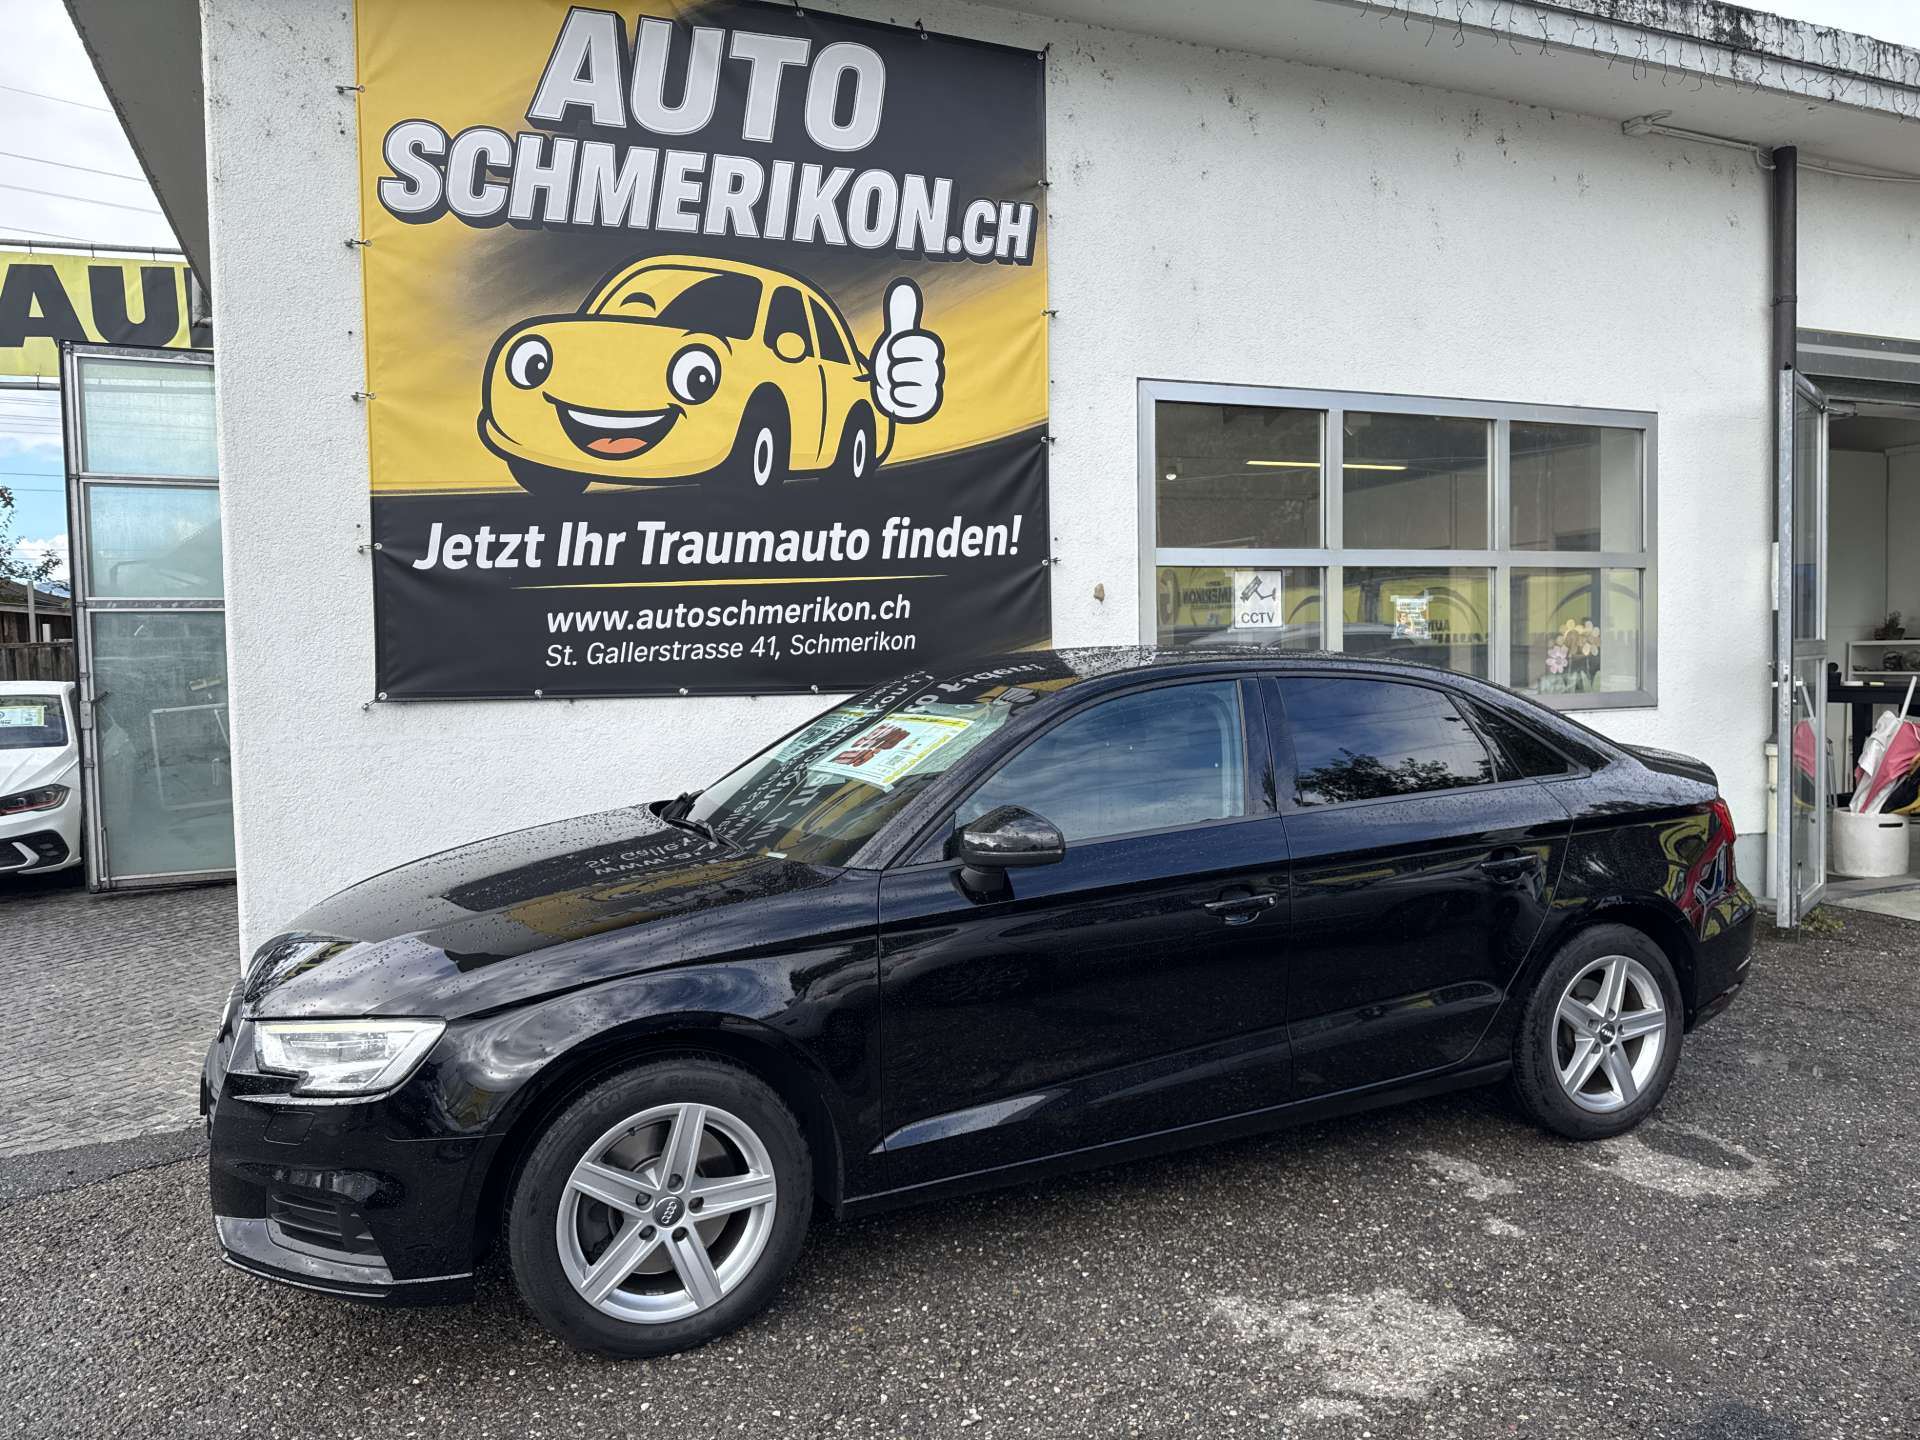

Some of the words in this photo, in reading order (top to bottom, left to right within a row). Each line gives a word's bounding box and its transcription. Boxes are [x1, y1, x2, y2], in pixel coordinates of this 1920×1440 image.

[530, 7, 886, 152] AUTO
[380, 121, 1034, 259] SCHMERIKON.CH
[0, 263, 213, 349] AU
[412, 522, 546, 570] Jetzt
[557, 521, 627, 567] Ihr
[636, 520, 870, 565] Traumauto
[881, 514, 1023, 560] finden!
[547, 594, 912, 633] www.autoschmerikon.ch
[1241, 612, 1275, 624] CCTV
[545, 644, 577, 667] St.
[586, 640, 744, 665] Gallerstrasse
[750, 635, 781, 661] 41,
[790, 630, 916, 656] Schmerikon
